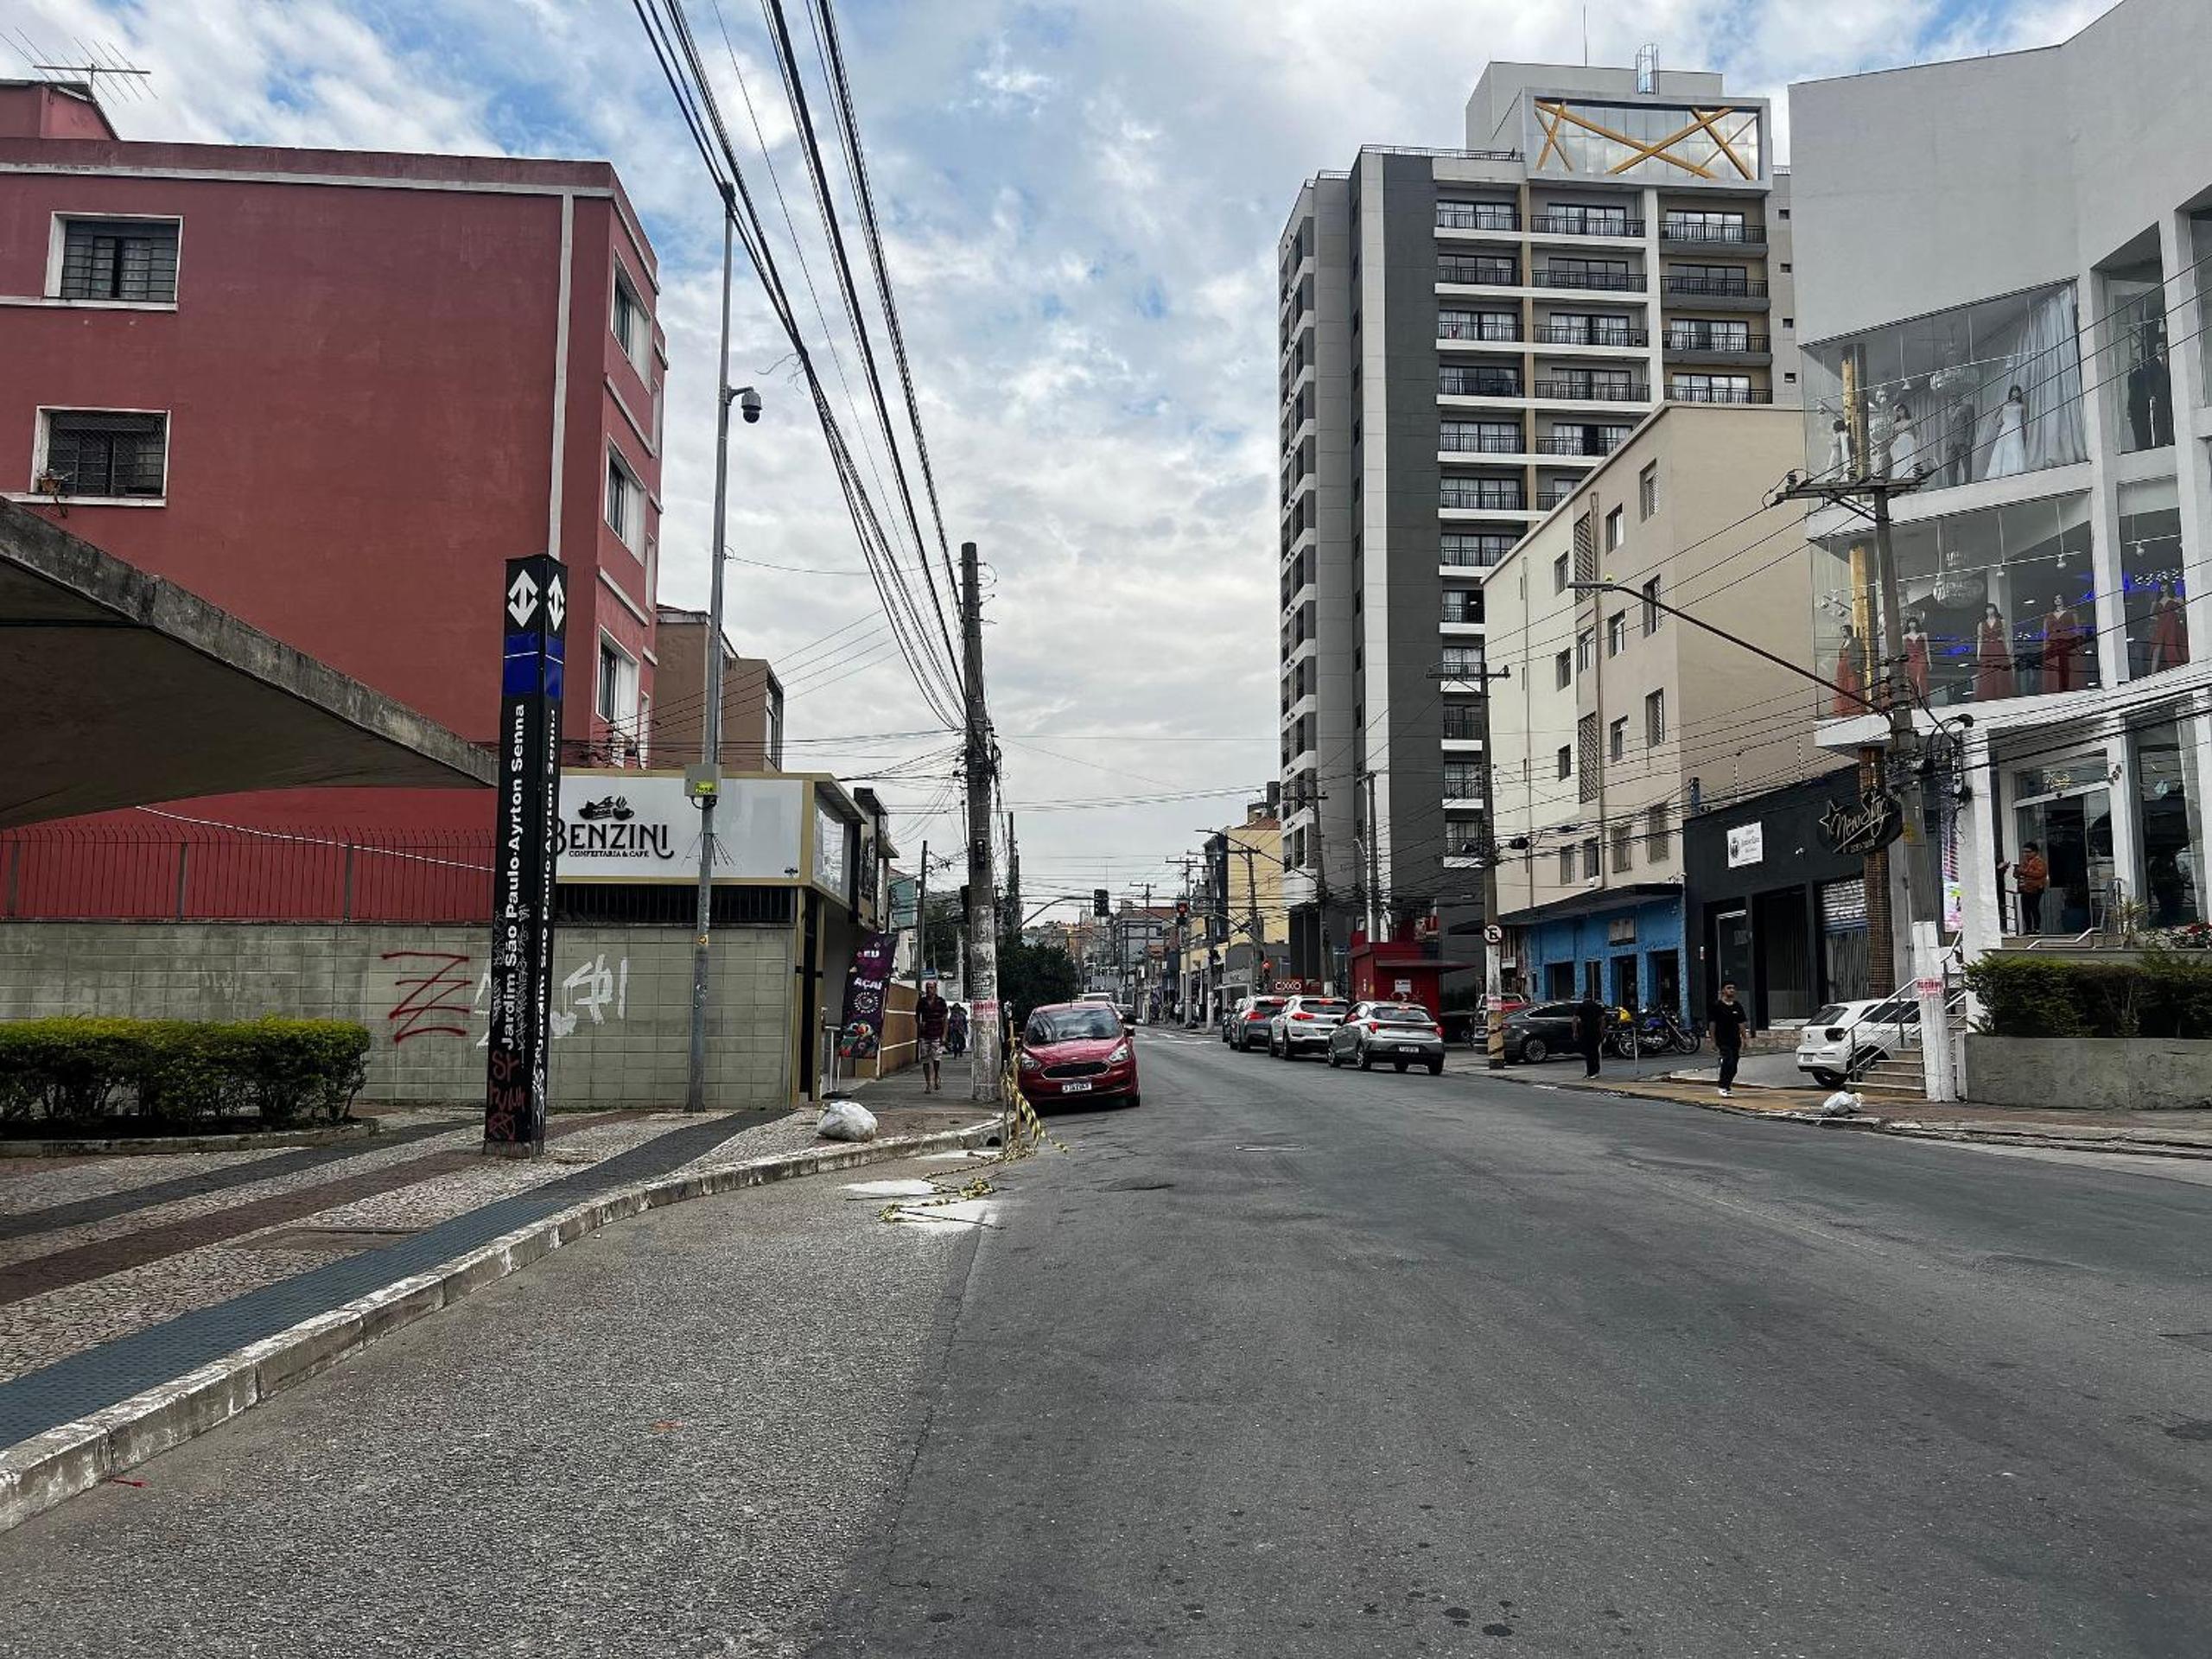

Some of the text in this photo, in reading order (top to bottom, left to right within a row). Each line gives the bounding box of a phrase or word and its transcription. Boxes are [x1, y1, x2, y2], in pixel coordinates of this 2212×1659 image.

[511, 704, 524, 772] Senna
[556, 818, 674, 859] BENZINI
[505, 925, 518, 967] São
[501, 973, 516, 1050] Jardim
